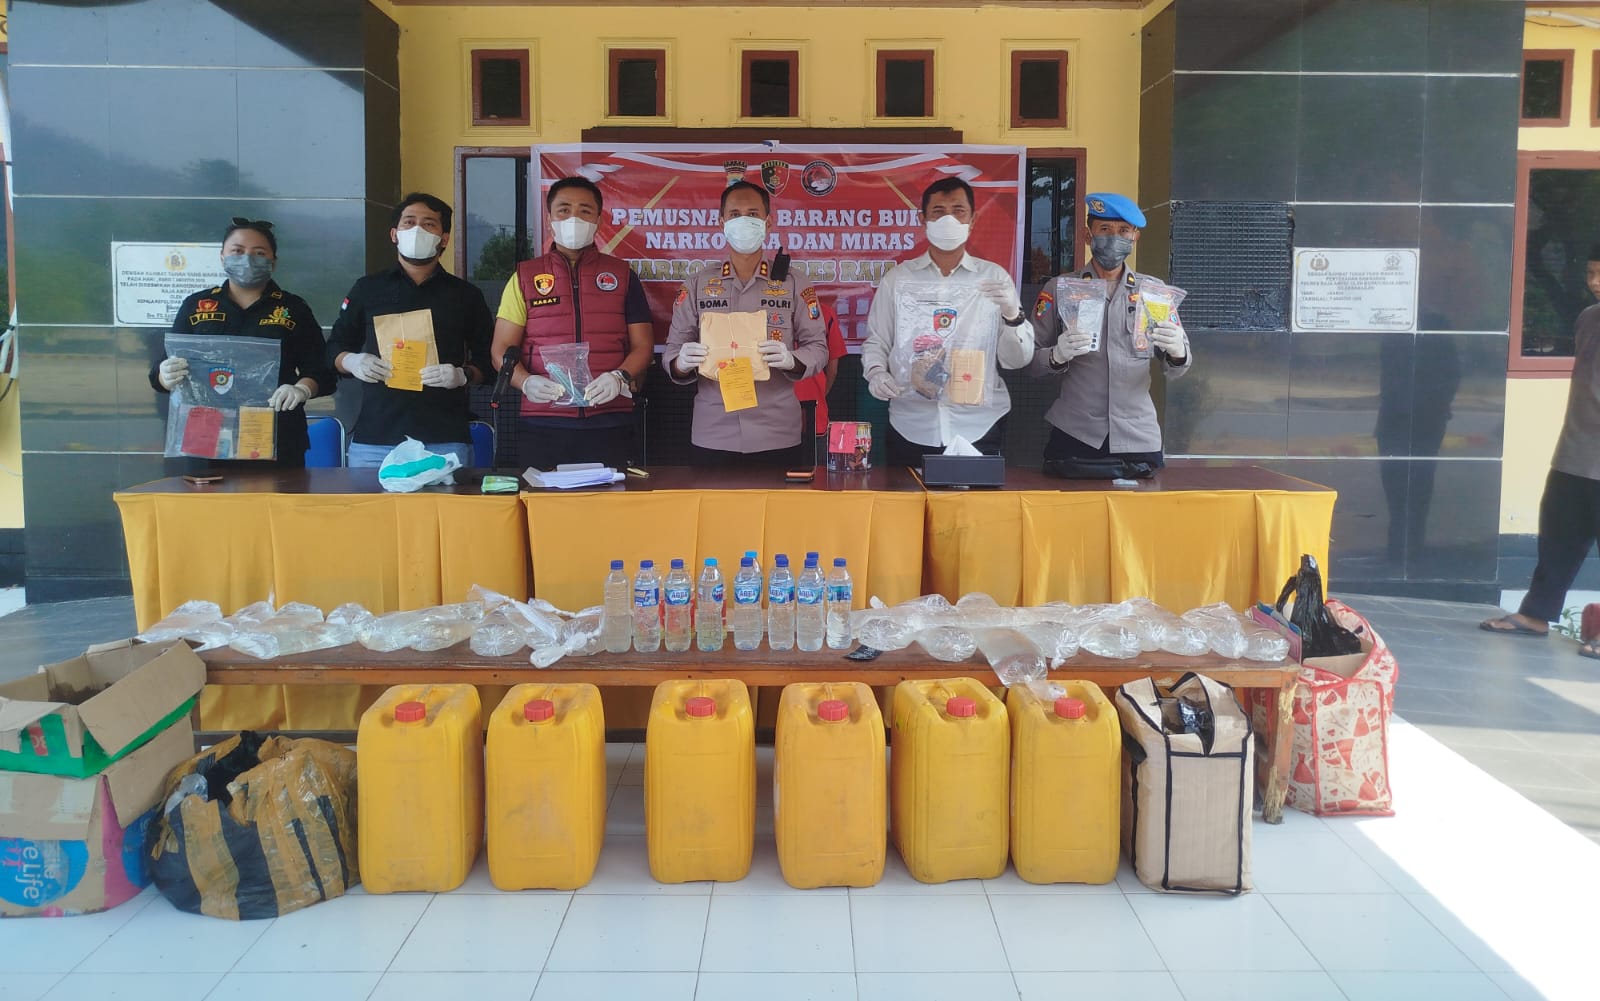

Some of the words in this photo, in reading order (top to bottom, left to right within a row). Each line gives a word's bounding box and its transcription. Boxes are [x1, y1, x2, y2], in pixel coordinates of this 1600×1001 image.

[611, 208, 720, 226] PEMUSNA
[776, 209, 872, 227] BARANG
[878, 209, 923, 227] BUK
[645, 232, 781, 249] NARKOA
[787, 232, 835, 250] DAN
[841, 232, 915, 250] MIRAS
[699, 299, 728, 309] BOMA
[760, 298, 791, 309] POLRI
